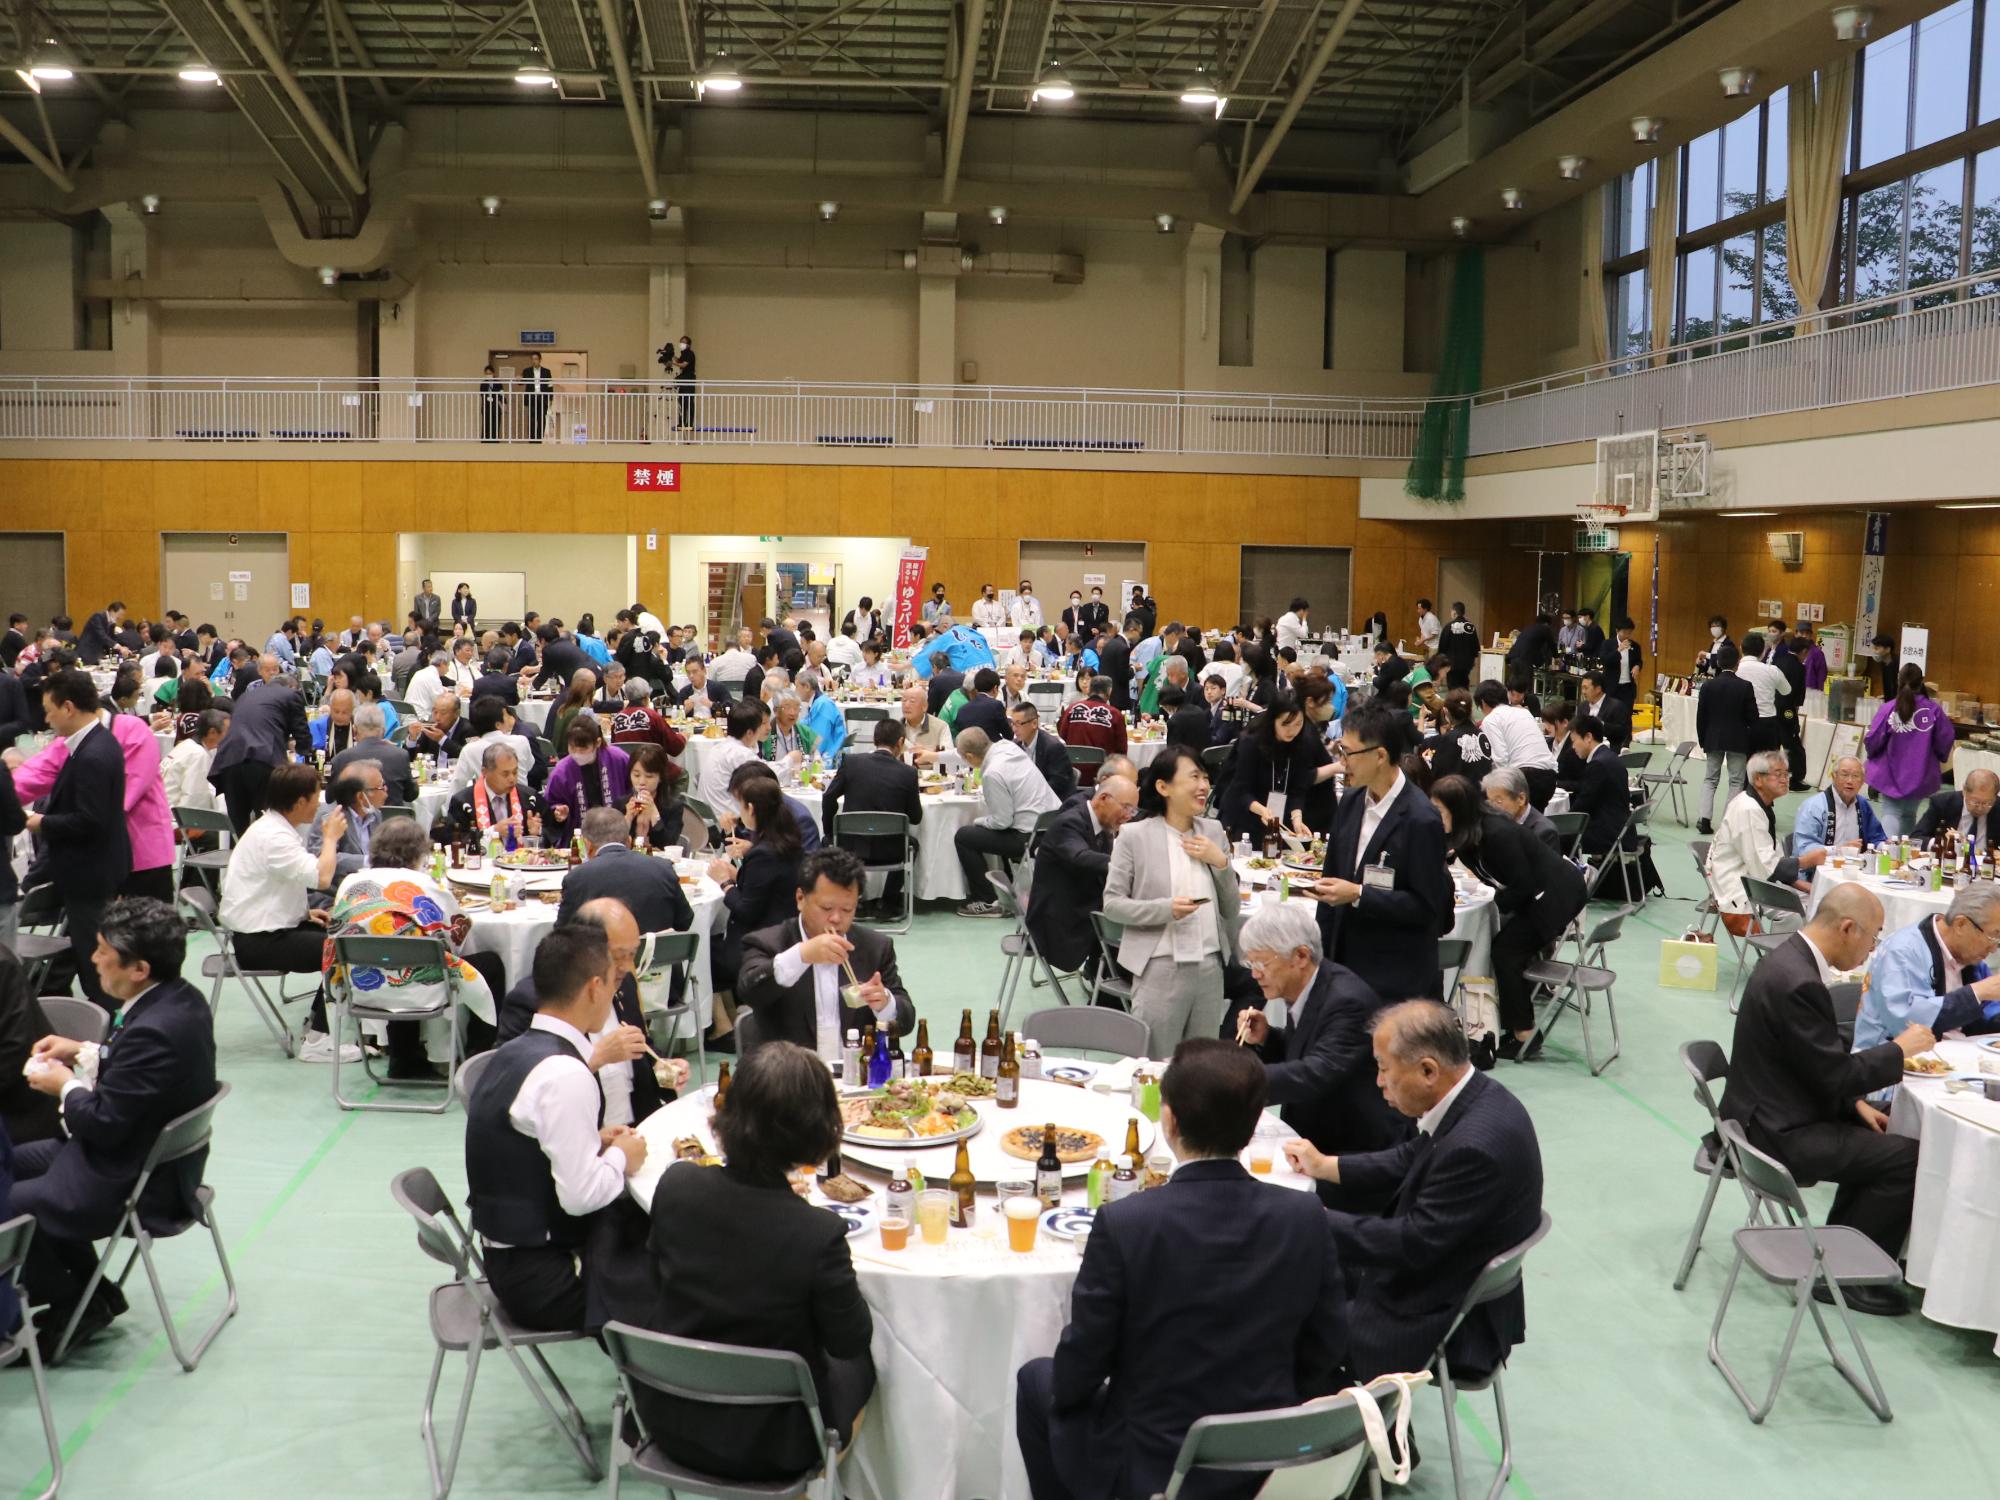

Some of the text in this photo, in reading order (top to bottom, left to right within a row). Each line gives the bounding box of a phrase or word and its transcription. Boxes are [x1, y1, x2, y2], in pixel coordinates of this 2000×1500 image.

[633, 468, 675, 486] 禁煙
[229, 534, 238, 545] G
[1085, 544, 1093, 556] H
[896, 586, 915, 647] ゆうパック
[1902, 646, 1924, 658] お飲み物
